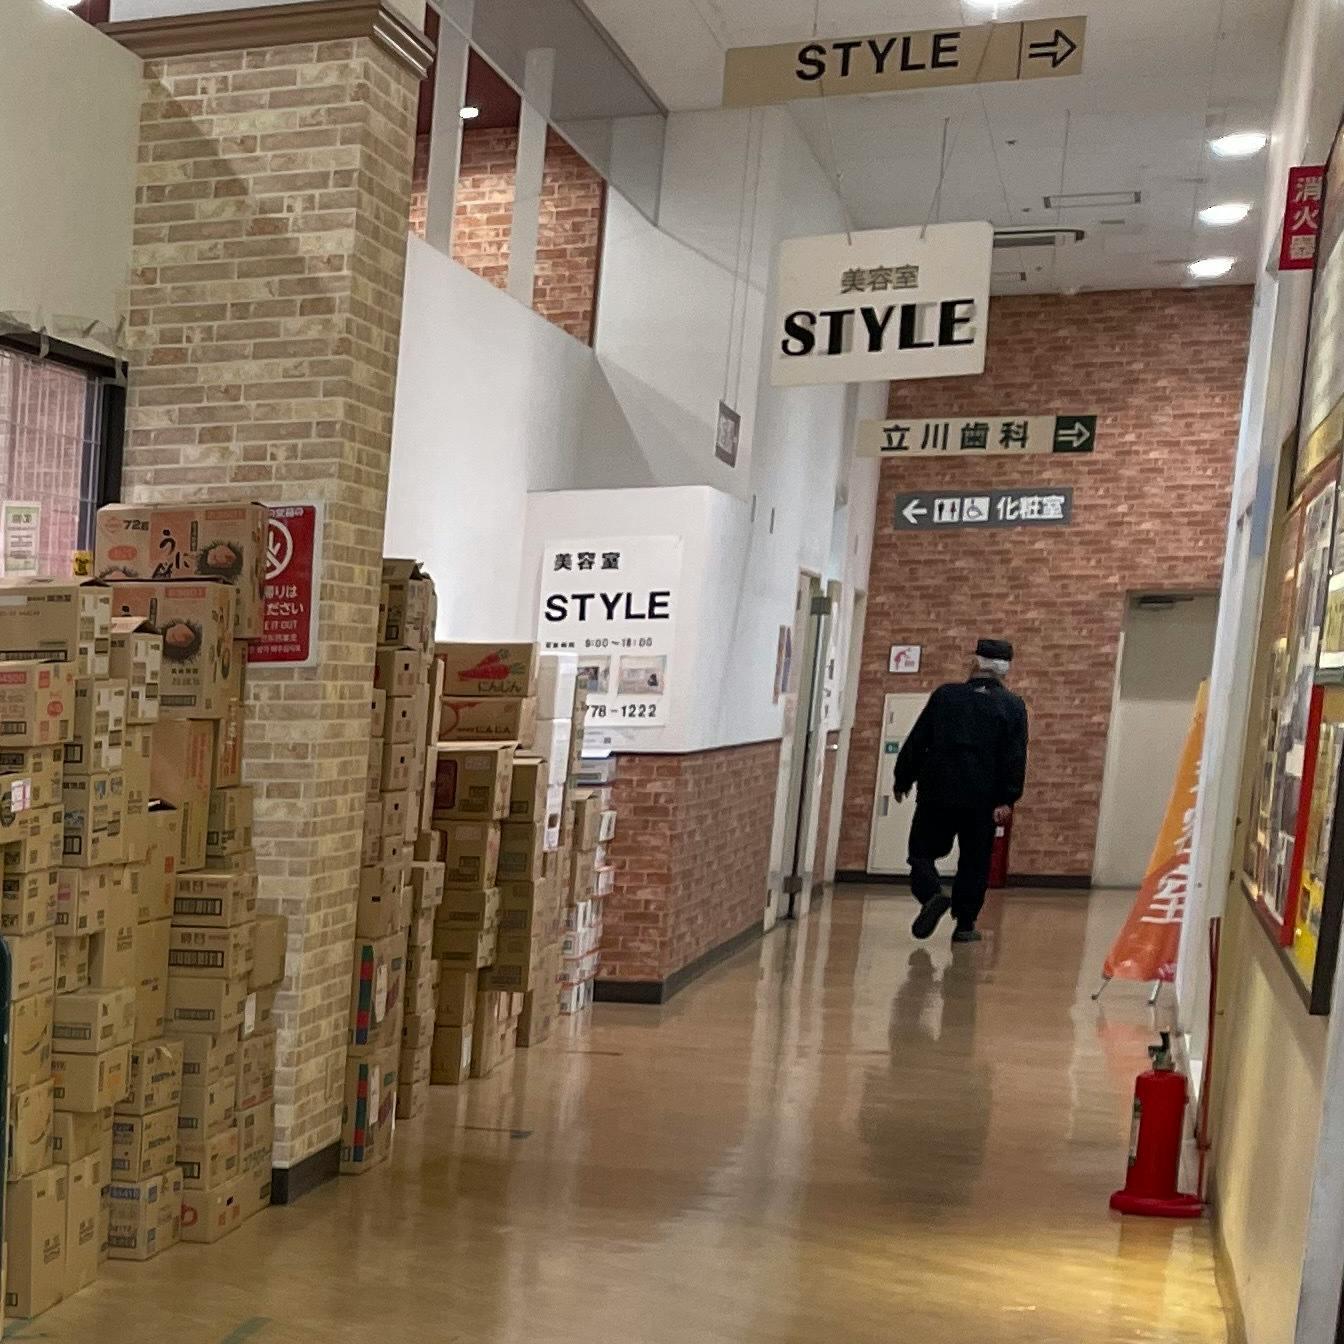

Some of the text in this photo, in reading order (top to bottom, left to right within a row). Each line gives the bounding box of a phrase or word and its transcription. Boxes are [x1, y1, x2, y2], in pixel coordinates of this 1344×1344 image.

[796, 32, 961, 80] STYLE
[840, 264, 920, 294] 美容室
[781, 298, 975, 356] STYLE
[880, 420, 1031, 451] 立川歯科
[996, 495, 1065, 520] 化粧室
[554, 552, 620, 571] 美容室
[545, 591, 670, 622] STYLE
[586, 704, 657, 718] 78-1222
